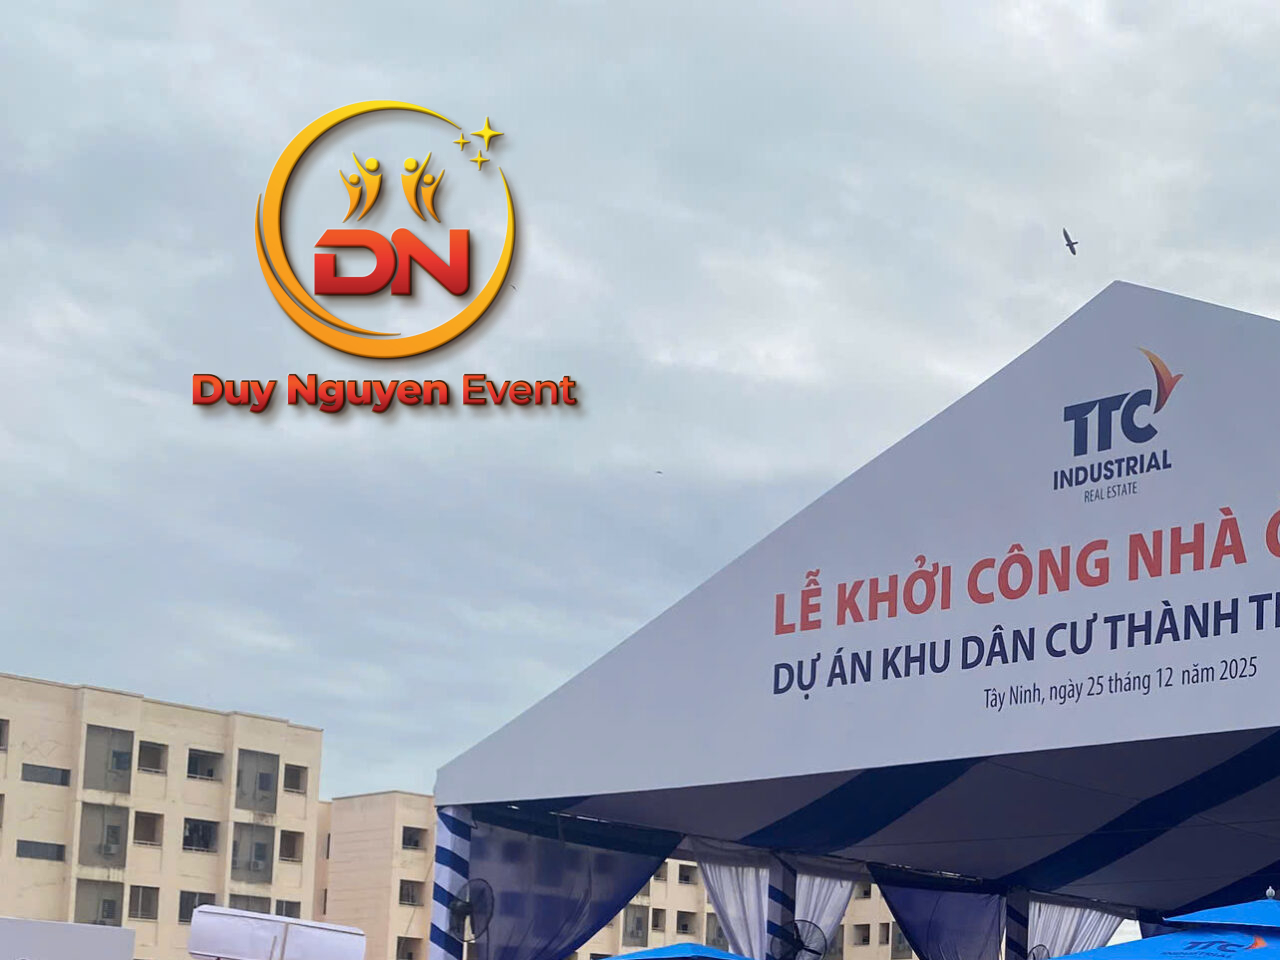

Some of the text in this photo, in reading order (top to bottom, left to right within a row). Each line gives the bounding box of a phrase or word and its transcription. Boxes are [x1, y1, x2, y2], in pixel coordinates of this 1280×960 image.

[1064, 389, 1158, 457] TTC
[1053, 450, 1172, 490] INDUSTRIAL
[1084, 482, 1138, 503] REAL ESTATE
[774, 568, 822, 635] LỄ
[836, 554, 951, 626] KHỞI
[967, 540, 1110, 605] CÔNG
[1128, 506, 1247, 581] NHÀ
[773, 652, 821, 701] DỰ
[826, 647, 872, 687] ÁN
[882, 639, 950, 680] KHU
[961, 624, 1035, 670] DÂN
[1045, 612, 1098, 658] CƯ
[1103, 600, 1239, 651] THÀNH
[984, 656, 1257, 712] Tây Ninh, ngày 25 tháng 12 năm 2025
